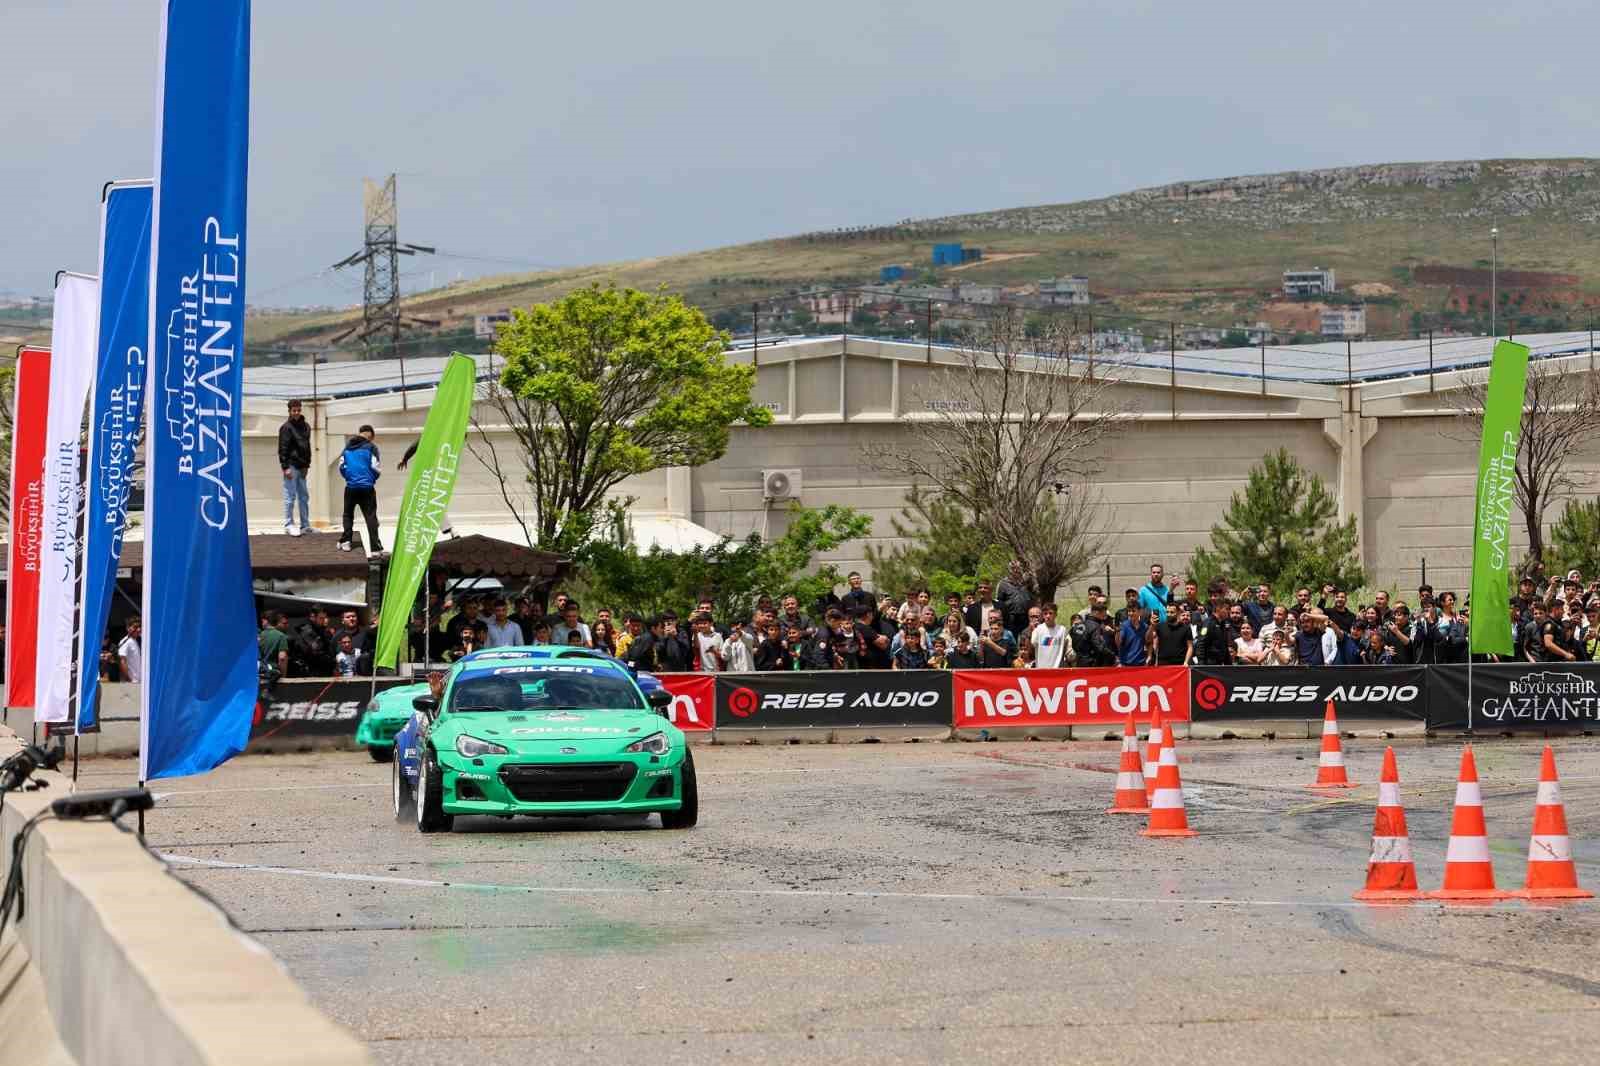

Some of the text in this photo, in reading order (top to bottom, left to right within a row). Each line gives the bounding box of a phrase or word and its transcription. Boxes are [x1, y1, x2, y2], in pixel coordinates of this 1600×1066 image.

[179, 269, 200, 476] BÜYÜKŞEHİR
[197, 216, 240, 531] GAZİANTEP
[1490, 430, 1518, 570] GAZİANTEP
[1229, 685, 1419, 702] REISS AUDIO
[1509, 679, 1598, 696] BÜYÜKŞEHİR
[761, 691, 940, 709] REISS AUDIO
[265, 701, 361, 720] REISS
